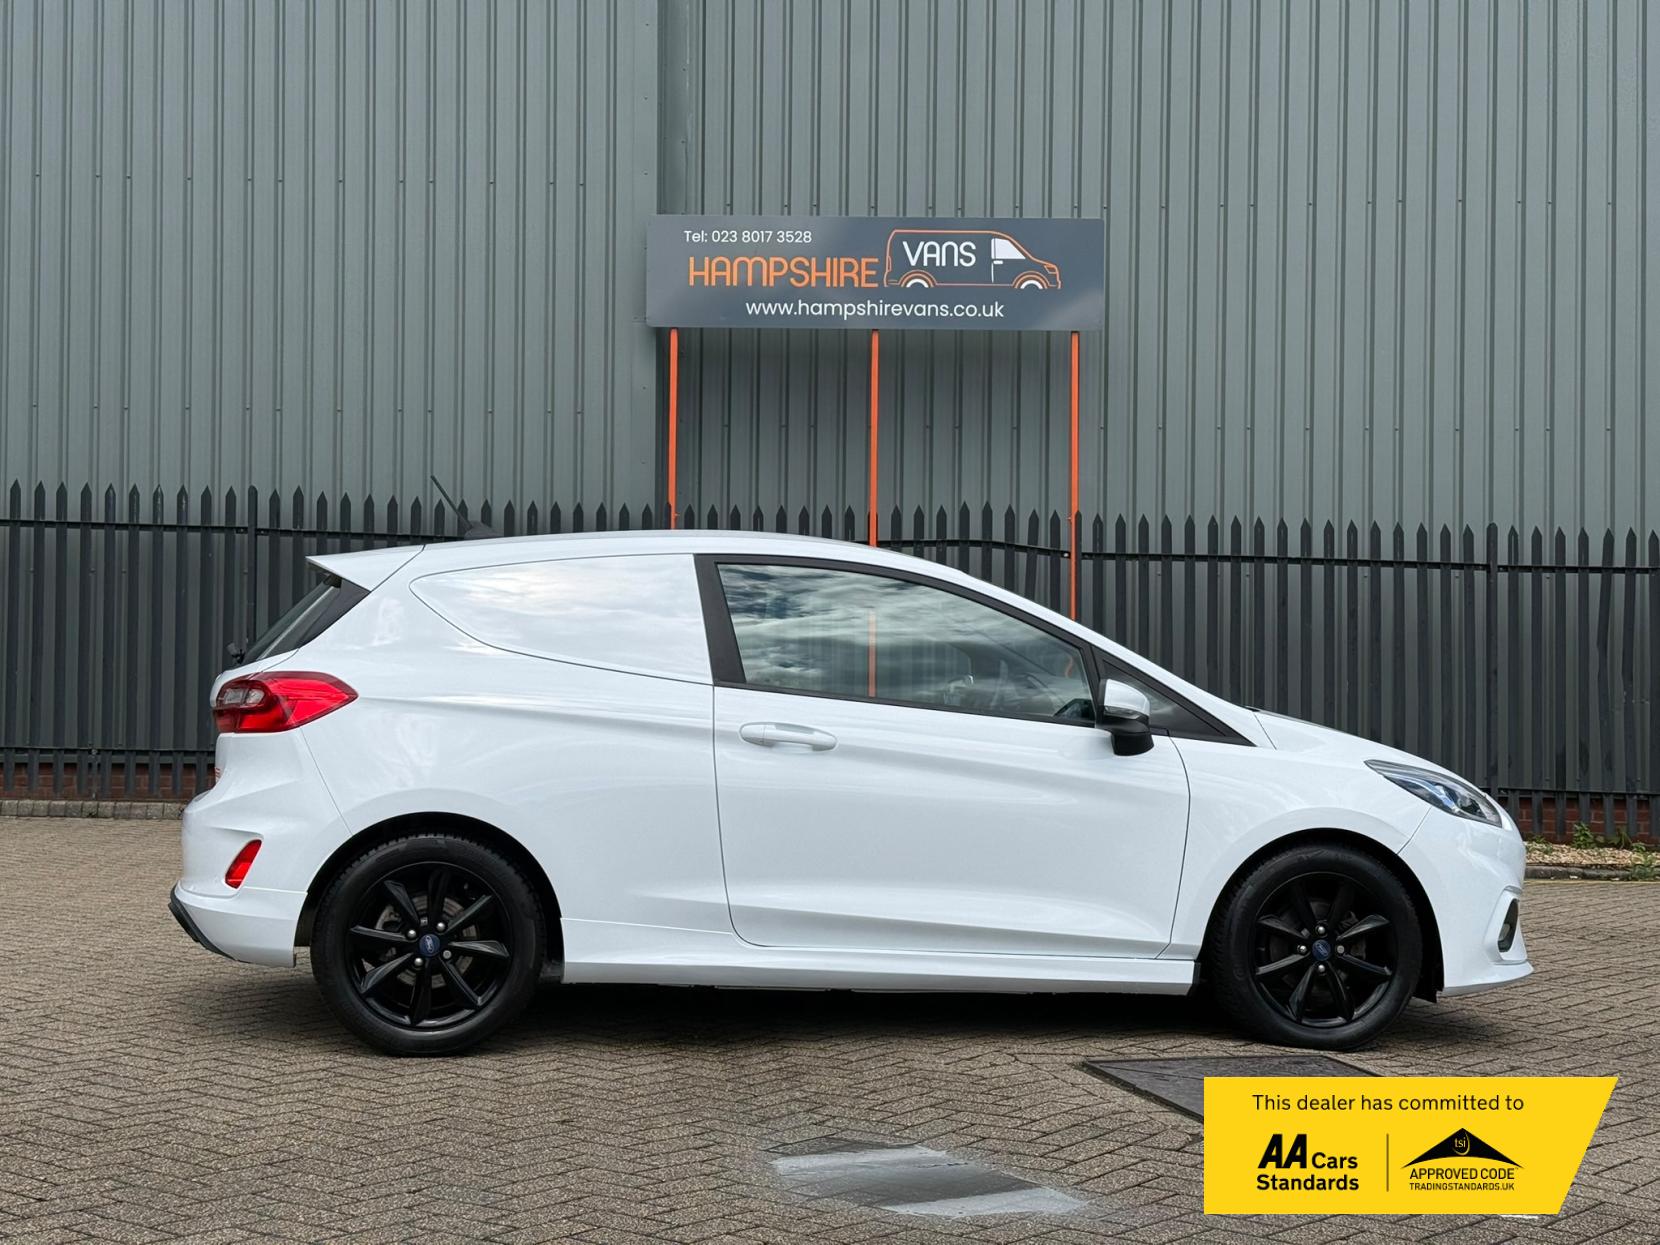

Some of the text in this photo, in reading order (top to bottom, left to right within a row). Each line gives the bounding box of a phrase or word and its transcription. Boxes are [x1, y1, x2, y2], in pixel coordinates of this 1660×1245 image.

[683, 229, 813, 244] Tel: 023 8017 3528
[688, 240, 978, 289] HAMPSHIRE VANS
[745, 299, 1005, 320] www.hampshirevans.co.uk
